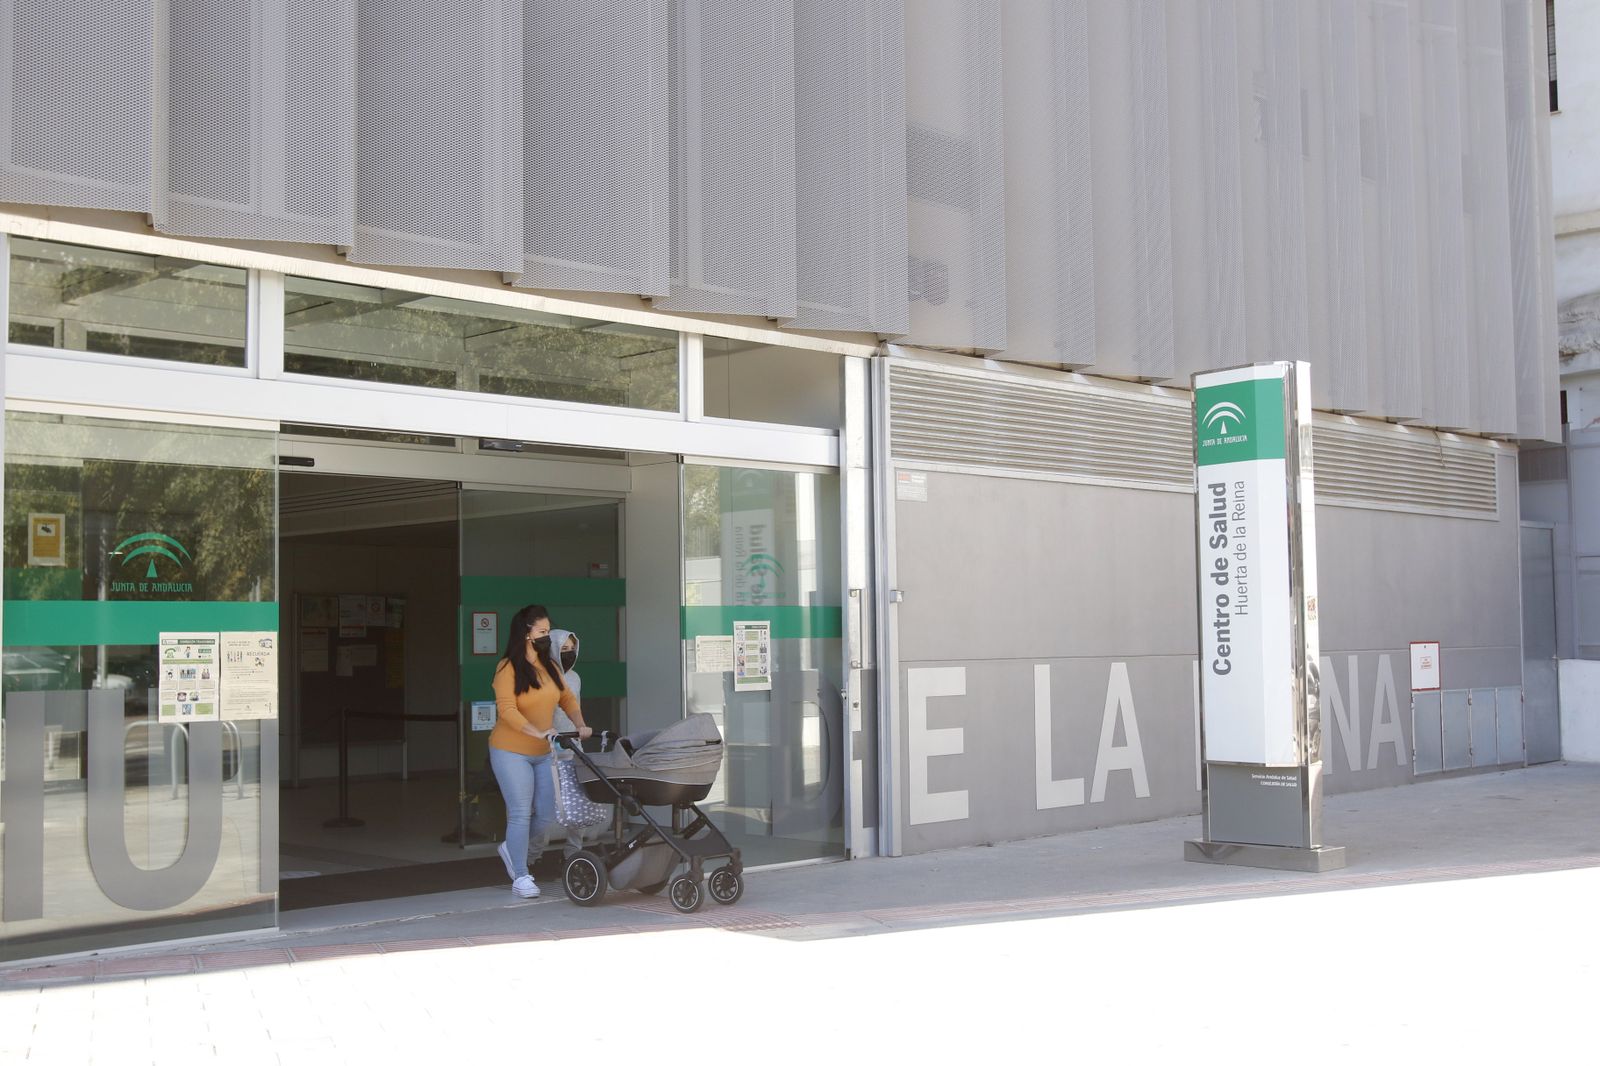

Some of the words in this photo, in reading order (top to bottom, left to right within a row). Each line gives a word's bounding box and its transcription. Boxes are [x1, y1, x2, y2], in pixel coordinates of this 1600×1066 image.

[1202, 438, 1216, 447] JUNTA
[1207, 481, 1228, 550] Salud
[1231, 480, 1246, 521] Reina
[1232, 526, 1246, 539] la
[1232, 543, 1247, 561] de
[110, 582, 135, 593] JUNTA
[138, 582, 148, 593] DE
[151, 581, 192, 593] ANDALUCIA
[1210, 556, 1230, 586] de
[1234, 564, 1249, 616] Huerta
[1211, 593, 1232, 676] Centro
[1033, 662, 1151, 810] LA
